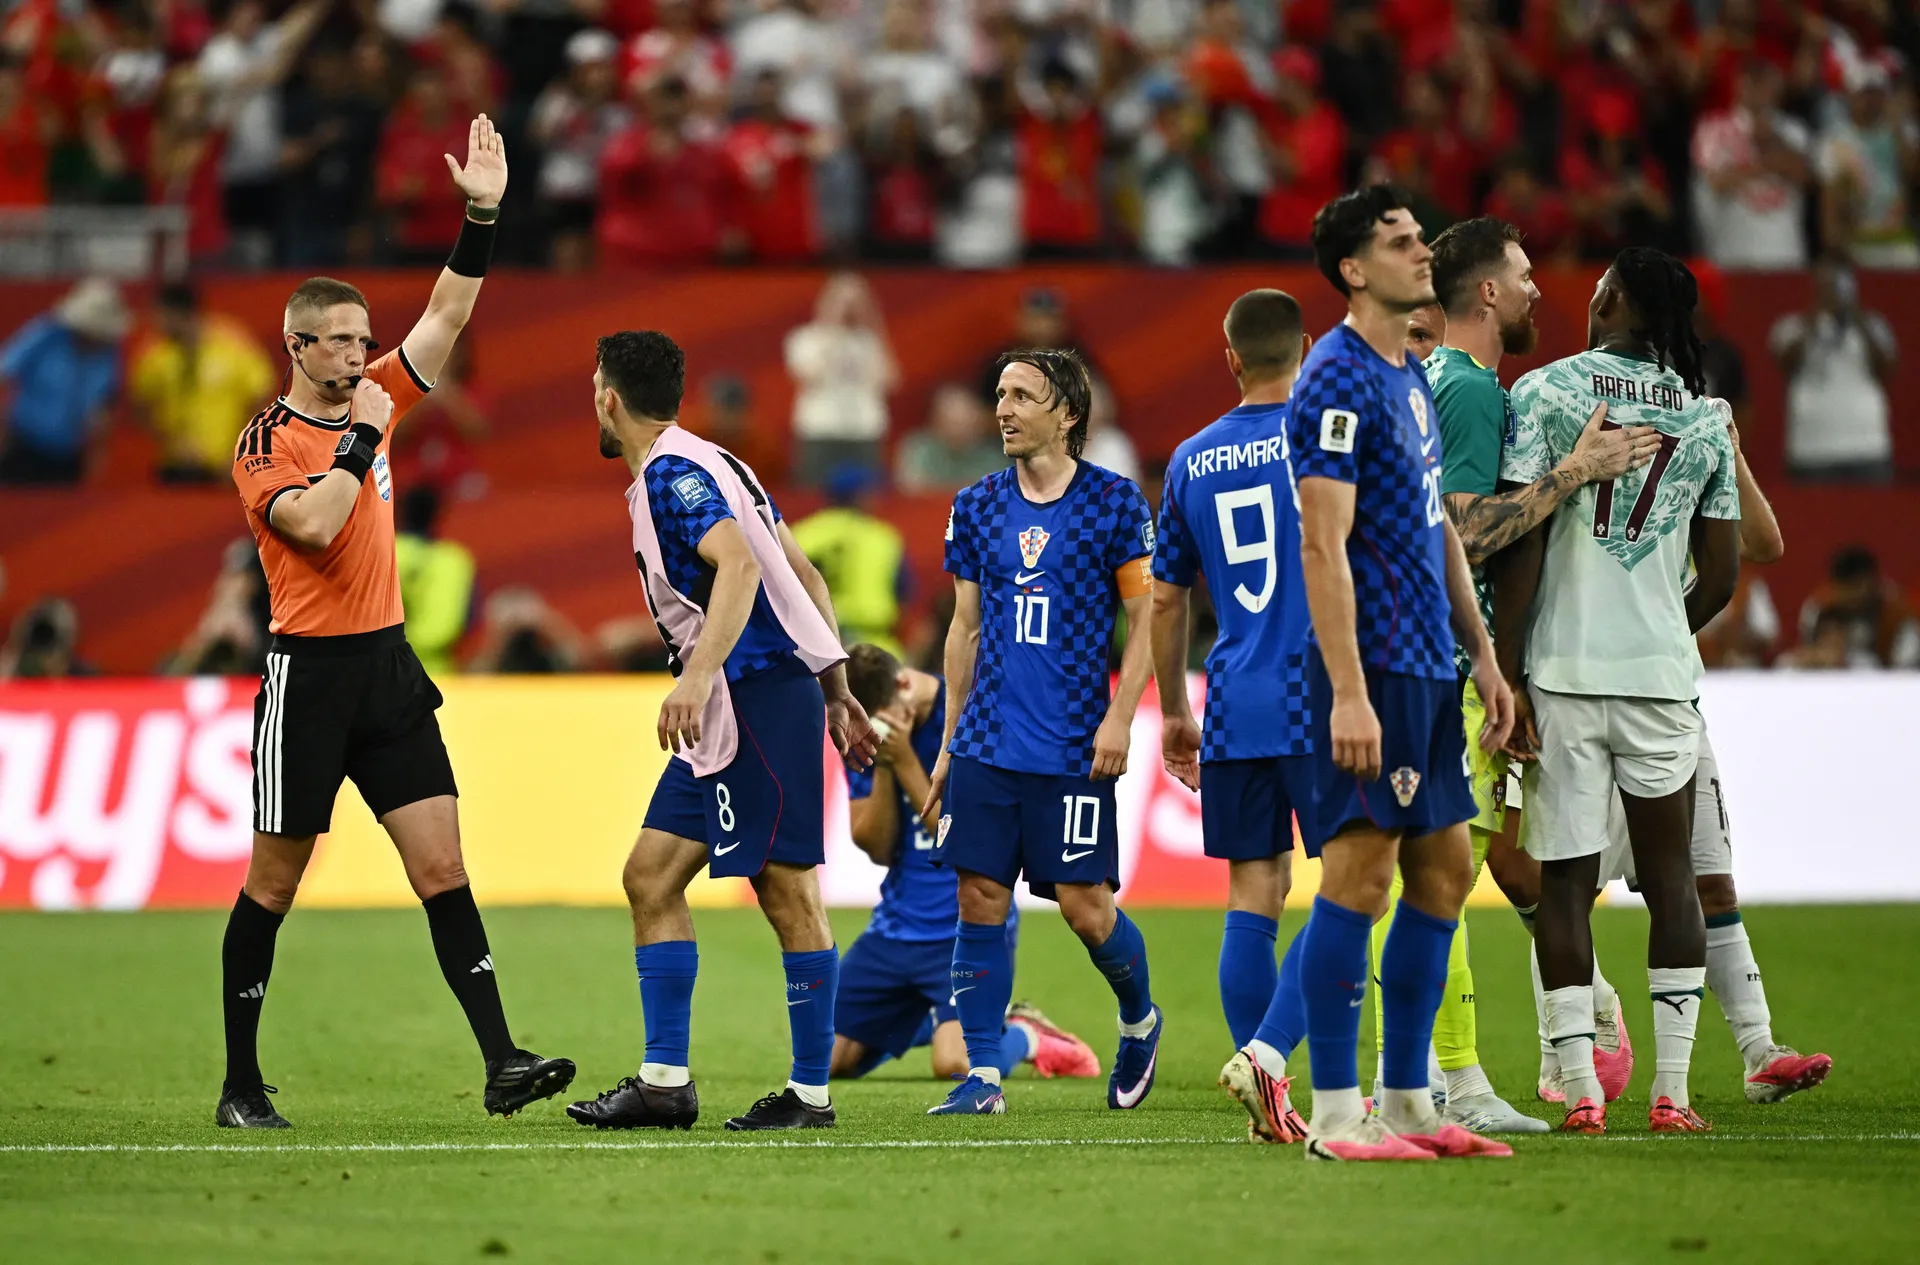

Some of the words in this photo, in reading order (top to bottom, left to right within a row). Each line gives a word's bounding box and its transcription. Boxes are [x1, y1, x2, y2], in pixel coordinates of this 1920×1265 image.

[1592, 374, 1637, 402] RAFA
[244, 456, 272, 472] FIFA
[373, 456, 386, 474] FIFA
[680, 480, 699, 495] UNITES
[1214, 483, 1277, 614] 9
[1013, 595, 1050, 645] 10
[716, 782, 735, 832] 8
[1063, 796, 1100, 846] 10
[1710, 777, 1730, 831] 1
